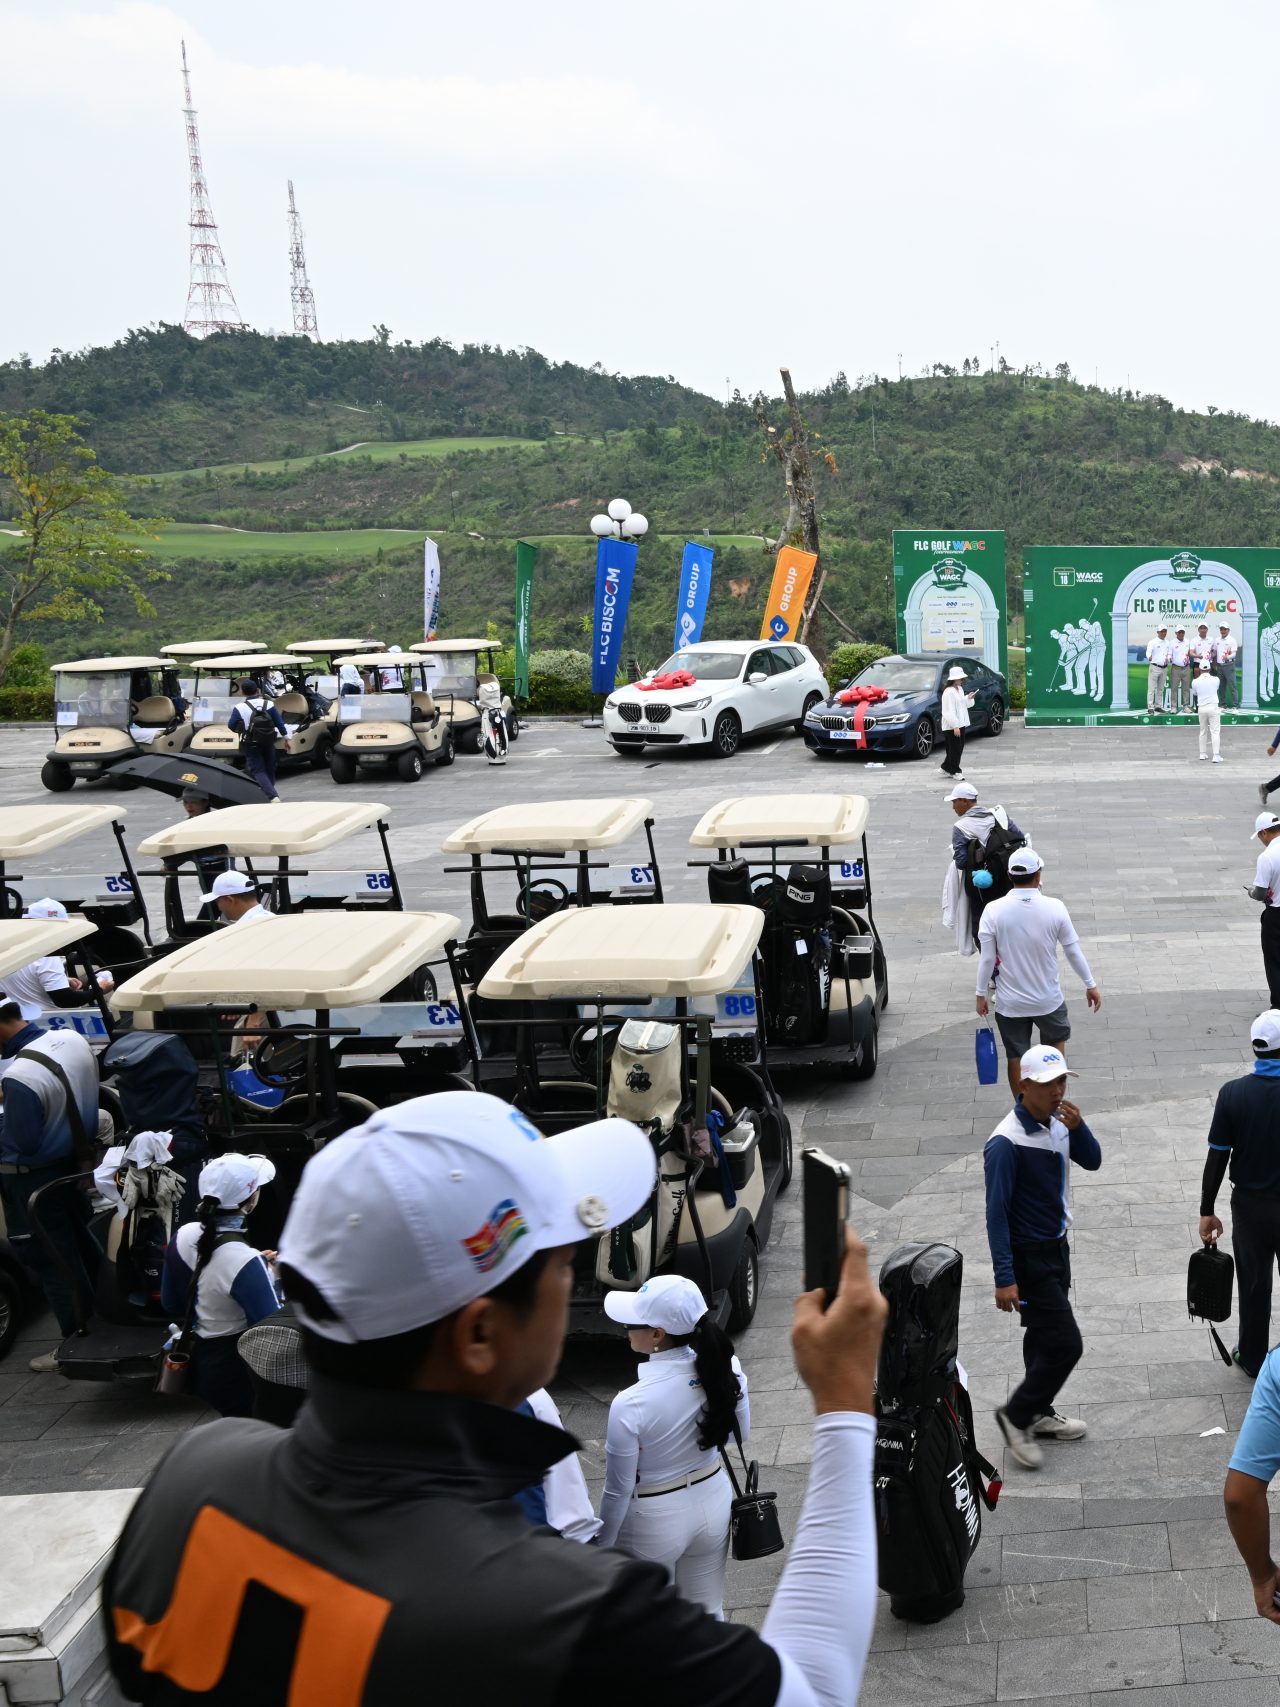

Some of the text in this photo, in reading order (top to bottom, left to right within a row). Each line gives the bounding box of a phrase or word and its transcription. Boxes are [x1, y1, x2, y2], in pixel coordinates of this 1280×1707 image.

[914, 541, 986, 551] FLC GOLF WAGC
[686, 563, 700, 609] GROUP
[780, 567, 798, 612] GROUP
[601, 567, 620, 634] BISCOM
[1134, 599, 1236, 613] FLC GOLF WAGC
[1160, 610, 1208, 621] Tournament
[788, 888, 811, 901] PING
[874, 1438, 904, 1451] HONMA
[946, 1462, 979, 1546] HONMA
